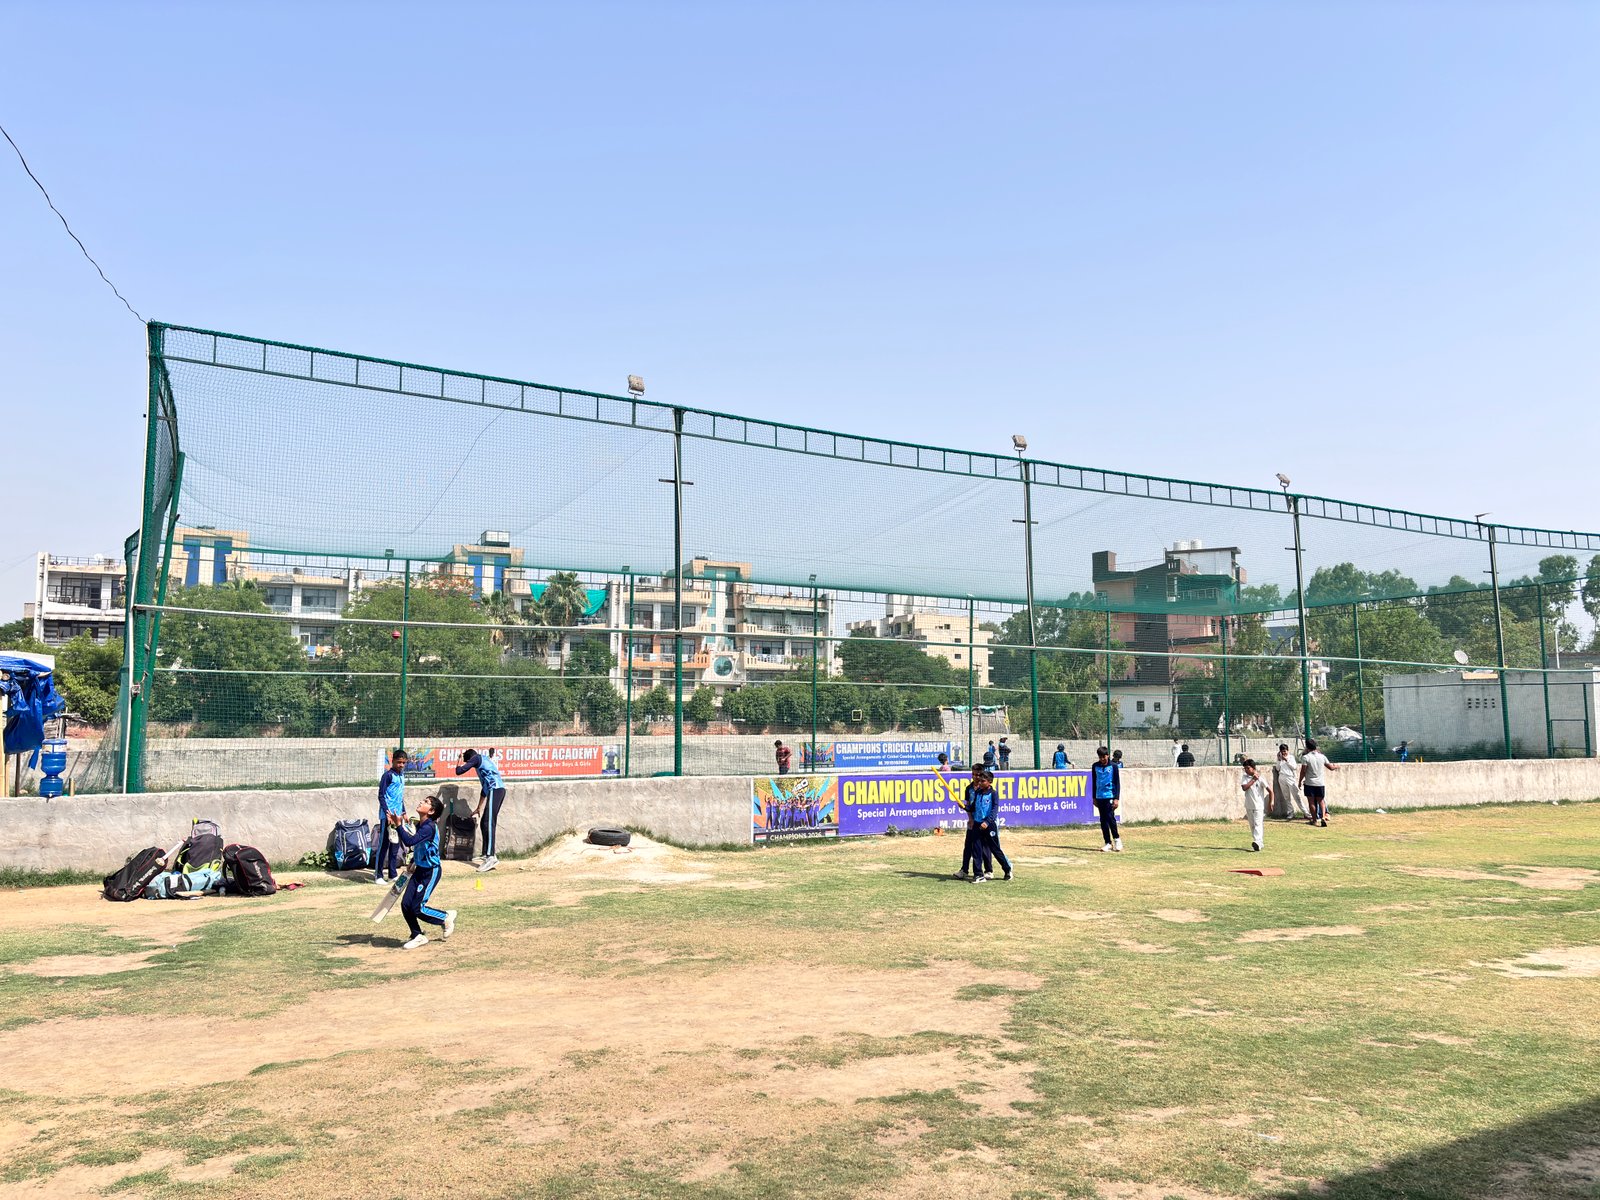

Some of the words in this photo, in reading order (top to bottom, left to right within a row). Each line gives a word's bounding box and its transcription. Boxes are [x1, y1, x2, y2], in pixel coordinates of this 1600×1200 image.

[506, 748, 549, 760] CRICKET
[552, 747, 599, 760] ACADEMY
[836, 743, 881, 754] CHAMPIONS
[882, 742, 914, 753] CRICKET
[914, 742, 948, 753] ACADEMY
[843, 778, 946, 806] CHAMPIONS
[1017, 775, 1088, 799] ACADEMY
[857, 808, 887, 820] Special
[889, 806, 946, 818] Arrangements
[947, 805, 956, 814] of
[1022, 801, 1033, 811] for
[1034, 801, 1051, 812] Boys
[1053, 801, 1059, 810] &
[1060, 800, 1077, 810] Girls
[770, 832, 806, 841] CHAMPIONS
